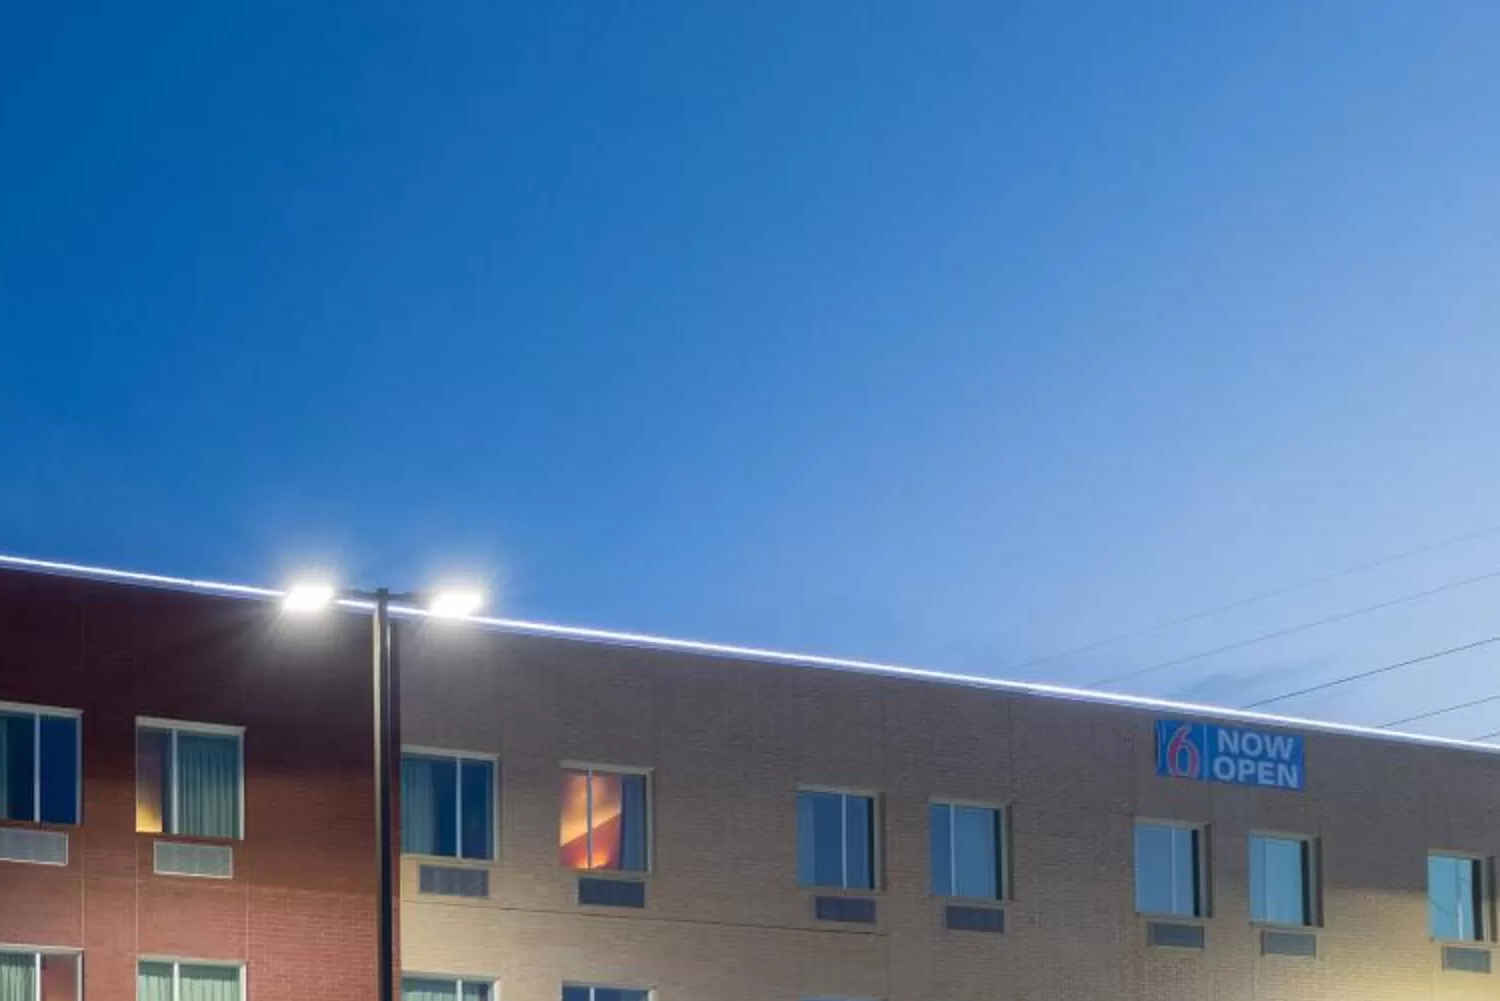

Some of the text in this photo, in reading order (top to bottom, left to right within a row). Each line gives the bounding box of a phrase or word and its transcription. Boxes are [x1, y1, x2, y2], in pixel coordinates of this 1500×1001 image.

[1167, 724, 1201, 780] 6
[1216, 727, 1294, 760] NOW
[1212, 755, 1299, 788] OPEN
